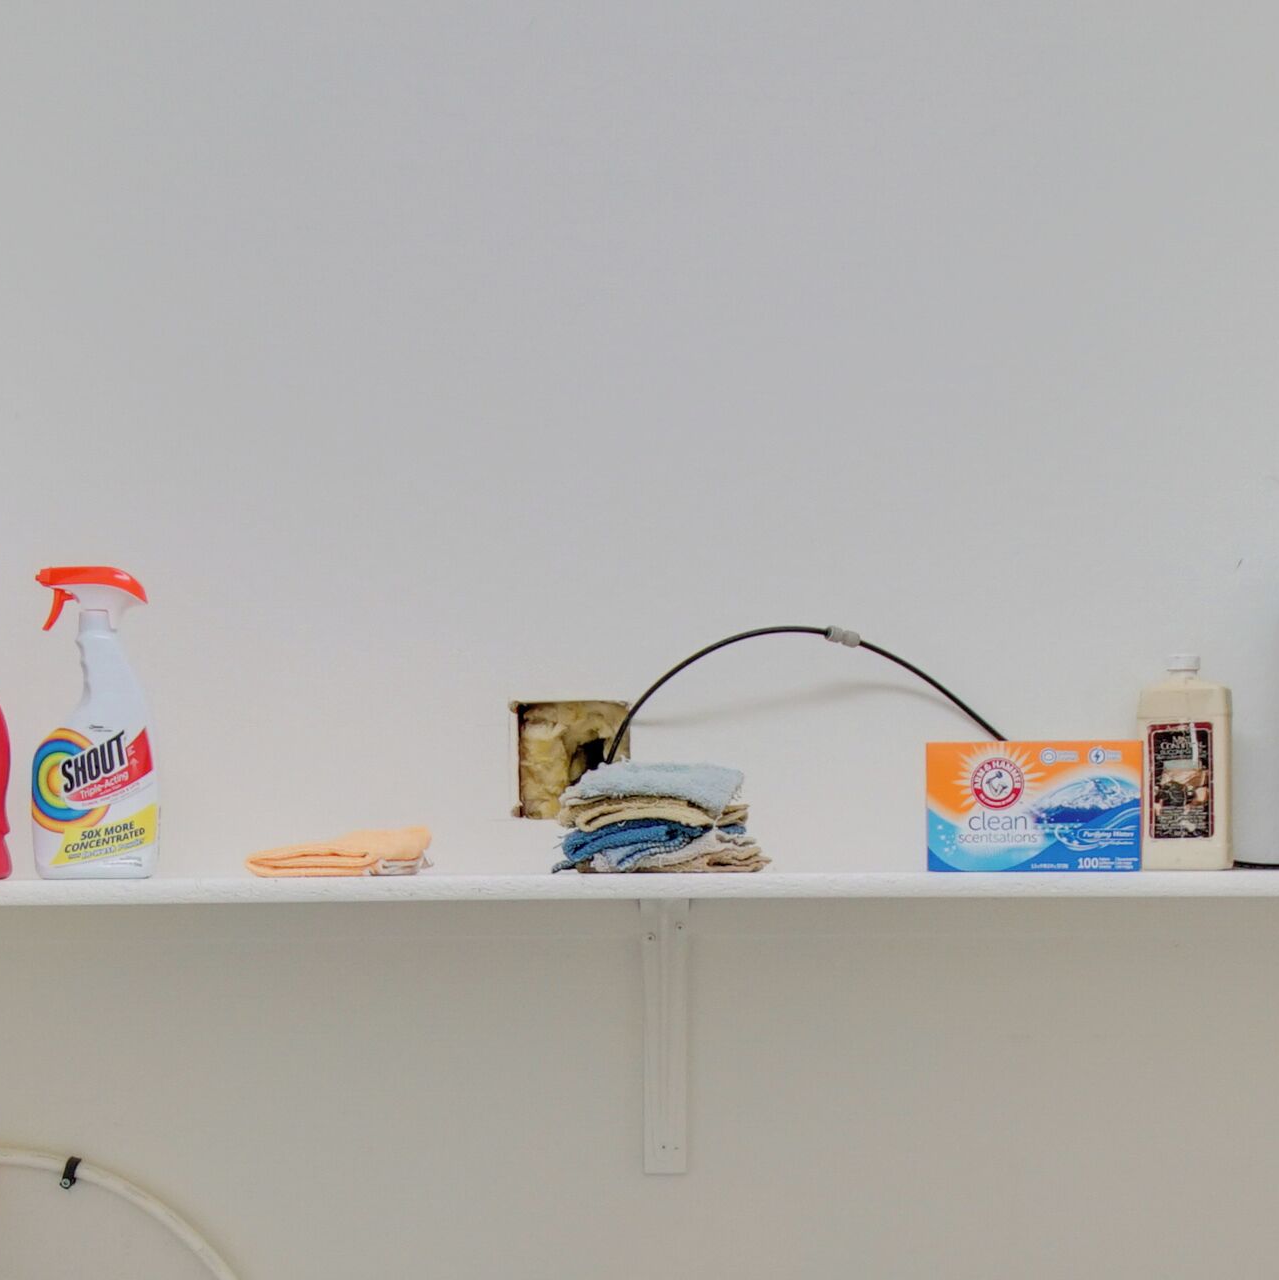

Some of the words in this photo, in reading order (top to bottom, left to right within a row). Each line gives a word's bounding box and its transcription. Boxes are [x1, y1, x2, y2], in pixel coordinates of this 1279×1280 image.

[61, 730, 125, 793] SHOUT
[80, 771, 129, 799] Triple-Acting
[81, 829, 101, 840] 50X
[104, 821, 134, 836] MORE
[969, 811, 1027, 831] clean
[64, 827, 145, 853] CONCENTRATED
[958, 833, 1038, 844] scentsations
[1078, 857, 1099, 869] 100
